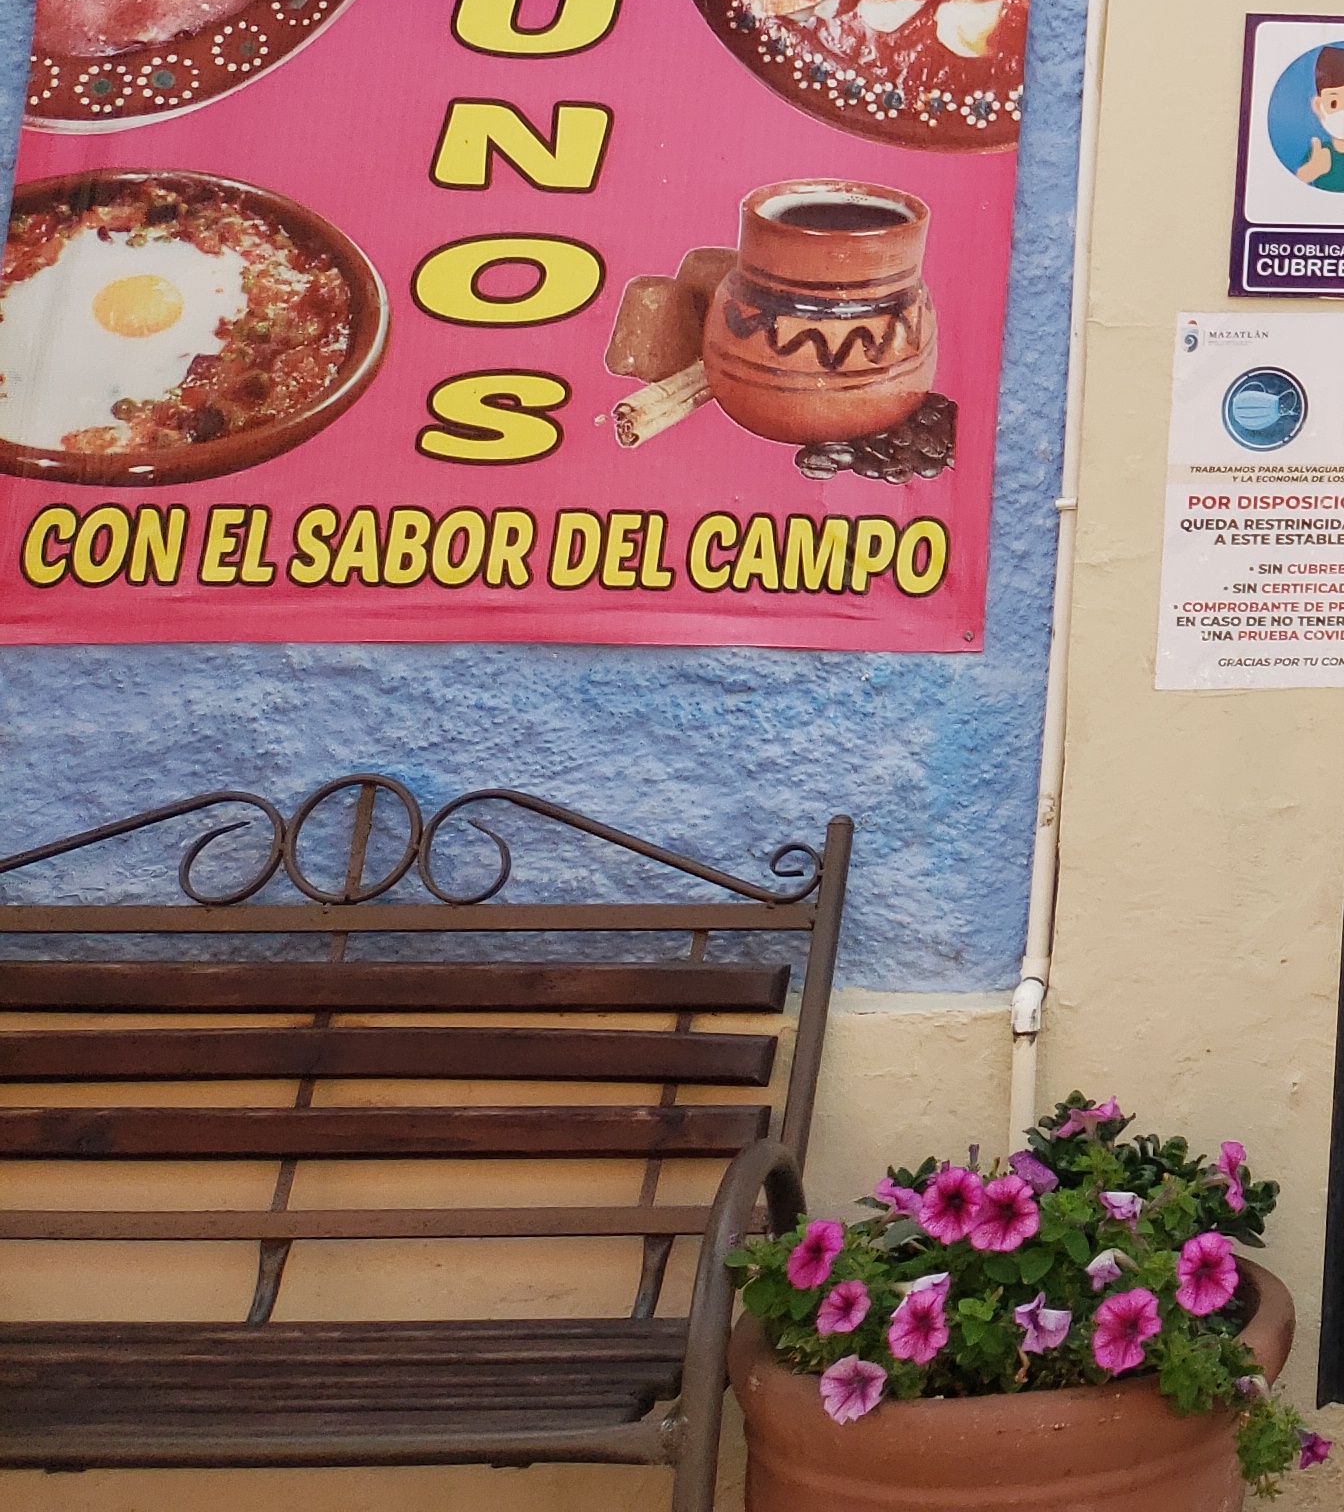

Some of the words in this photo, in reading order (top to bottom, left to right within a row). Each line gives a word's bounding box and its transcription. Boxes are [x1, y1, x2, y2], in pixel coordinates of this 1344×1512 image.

[1258, 244, 1290, 256] USO
[1209, 329, 1269, 338] MAZATLÁN
[1190, 466, 1256, 474] TRABAJAMOS
[1258, 466, 1284, 474] PARA
[1256, 474, 1309, 483] ECONOMÍA
[1311, 475, 1325, 483] DE
[1188, 495, 1231, 510] POR
[1180, 518, 1239, 532] QUEDA
[1214, 534, 1226, 545] A
[1231, 533, 1270, 545] ESTE
[20, 503, 186, 589] CON
[201, 503, 275, 590] EL
[289, 504, 538, 591] SABOR
[547, 509, 675, 593] DEL
[689, 511, 954, 599] CAMPO
[1258, 563, 1283, 575] SIN
[1232, 583, 1257, 594] SIN
[1182, 602, 1300, 613] COMPROBANTE
[1304, 602, 1324, 612] DE
[1176, 616, 1196, 627] EN
[1200, 616, 1241, 627] CASO
[1246, 616, 1267, 626] DE
[1270, 616, 1293, 626] NO
[1201, 630, 1234, 641] UNA
[1238, 630, 1300, 641] PRUEBA
[1218, 658, 1271, 667] GRACIAS
[1274, 657, 1300, 666] POR
[1303, 657, 1318, 666] TU
